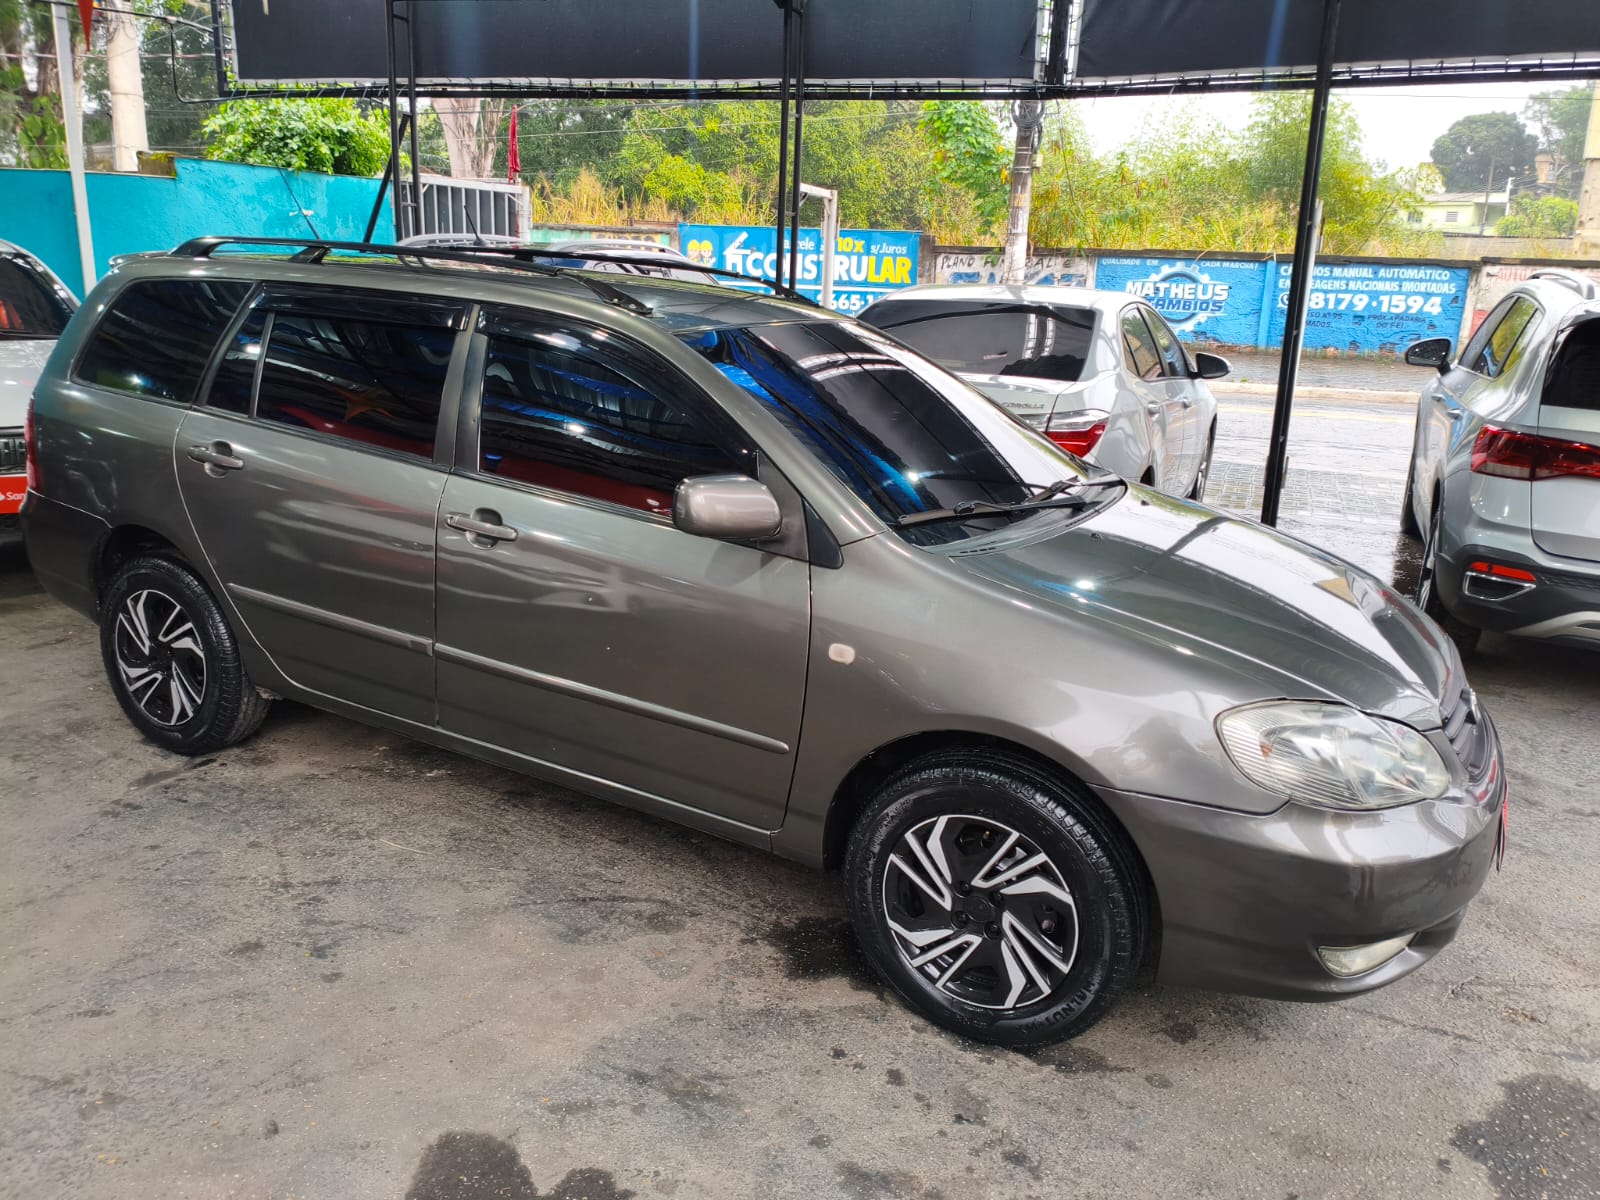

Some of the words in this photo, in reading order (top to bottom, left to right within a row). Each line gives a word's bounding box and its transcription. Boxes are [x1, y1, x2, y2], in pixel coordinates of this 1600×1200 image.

[837, 237, 865, 253] 10x
[746, 252, 912, 284] CONSRULAR
[941, 254, 975, 270] PLANO
[1102, 257, 1141, 267] QUALIDADE
[1146, 258, 1159, 267] EM
[1200, 261, 1221, 269] CADA
[1332, 266, 1375, 279] MANUAL
[1378, 266, 1450, 281] AUTOMÁTICO
[1126, 281, 1229, 301] MATHEUS
[1348, 280, 1400, 292] NACIONAIS
